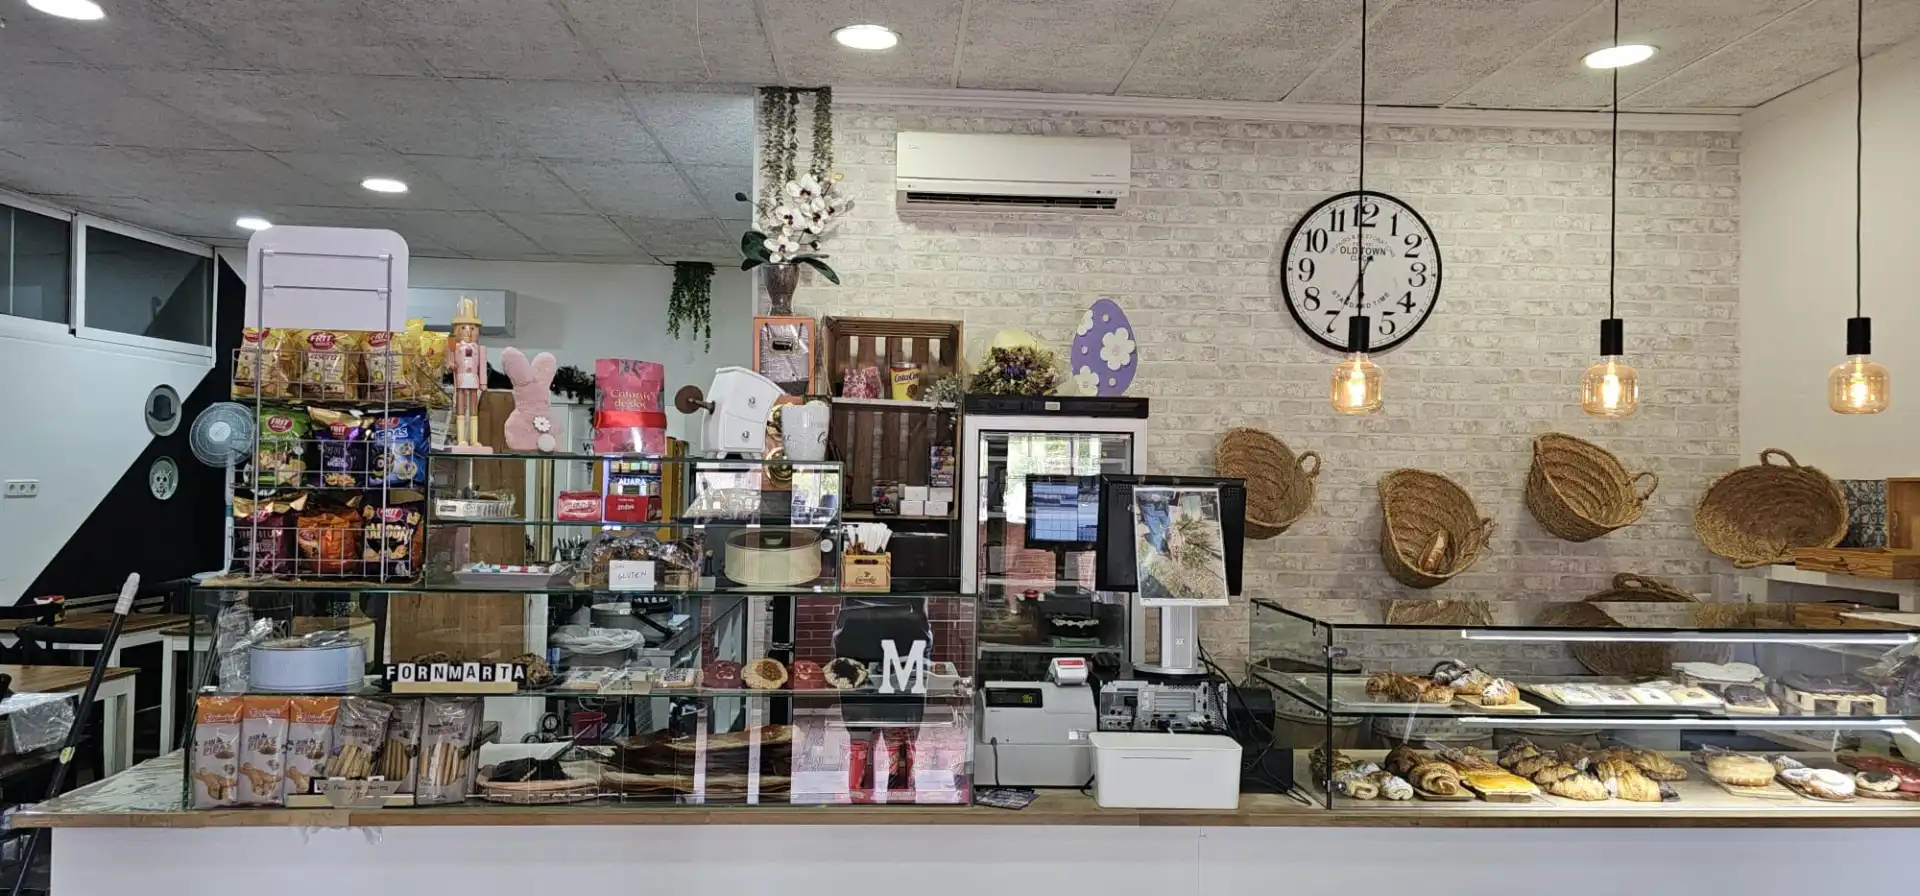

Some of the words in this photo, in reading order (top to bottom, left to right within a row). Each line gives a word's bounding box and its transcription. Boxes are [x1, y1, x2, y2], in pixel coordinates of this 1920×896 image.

[1328, 209, 1345, 232] 11
[1352, 203, 1380, 227] 12
[1390, 213, 1398, 236] 1
[1302, 228, 1328, 253] 10
[1340, 246, 1358, 255] OLD
[1404, 234, 1422, 258] 2
[1298, 258, 1315, 282] 9
[1408, 262, 1427, 287] 3
[1303, 287, 1320, 311] 8
[1372, 292, 1390, 306] TIME
[1396, 290, 1416, 313] 4
[1325, 310, 1341, 333] 7
[1379, 311, 1396, 335] 5
[270, 417, 290, 426] FRIT
[386, 664, 525, 681] FORNMARTA
[878, 639, 927, 693] M
